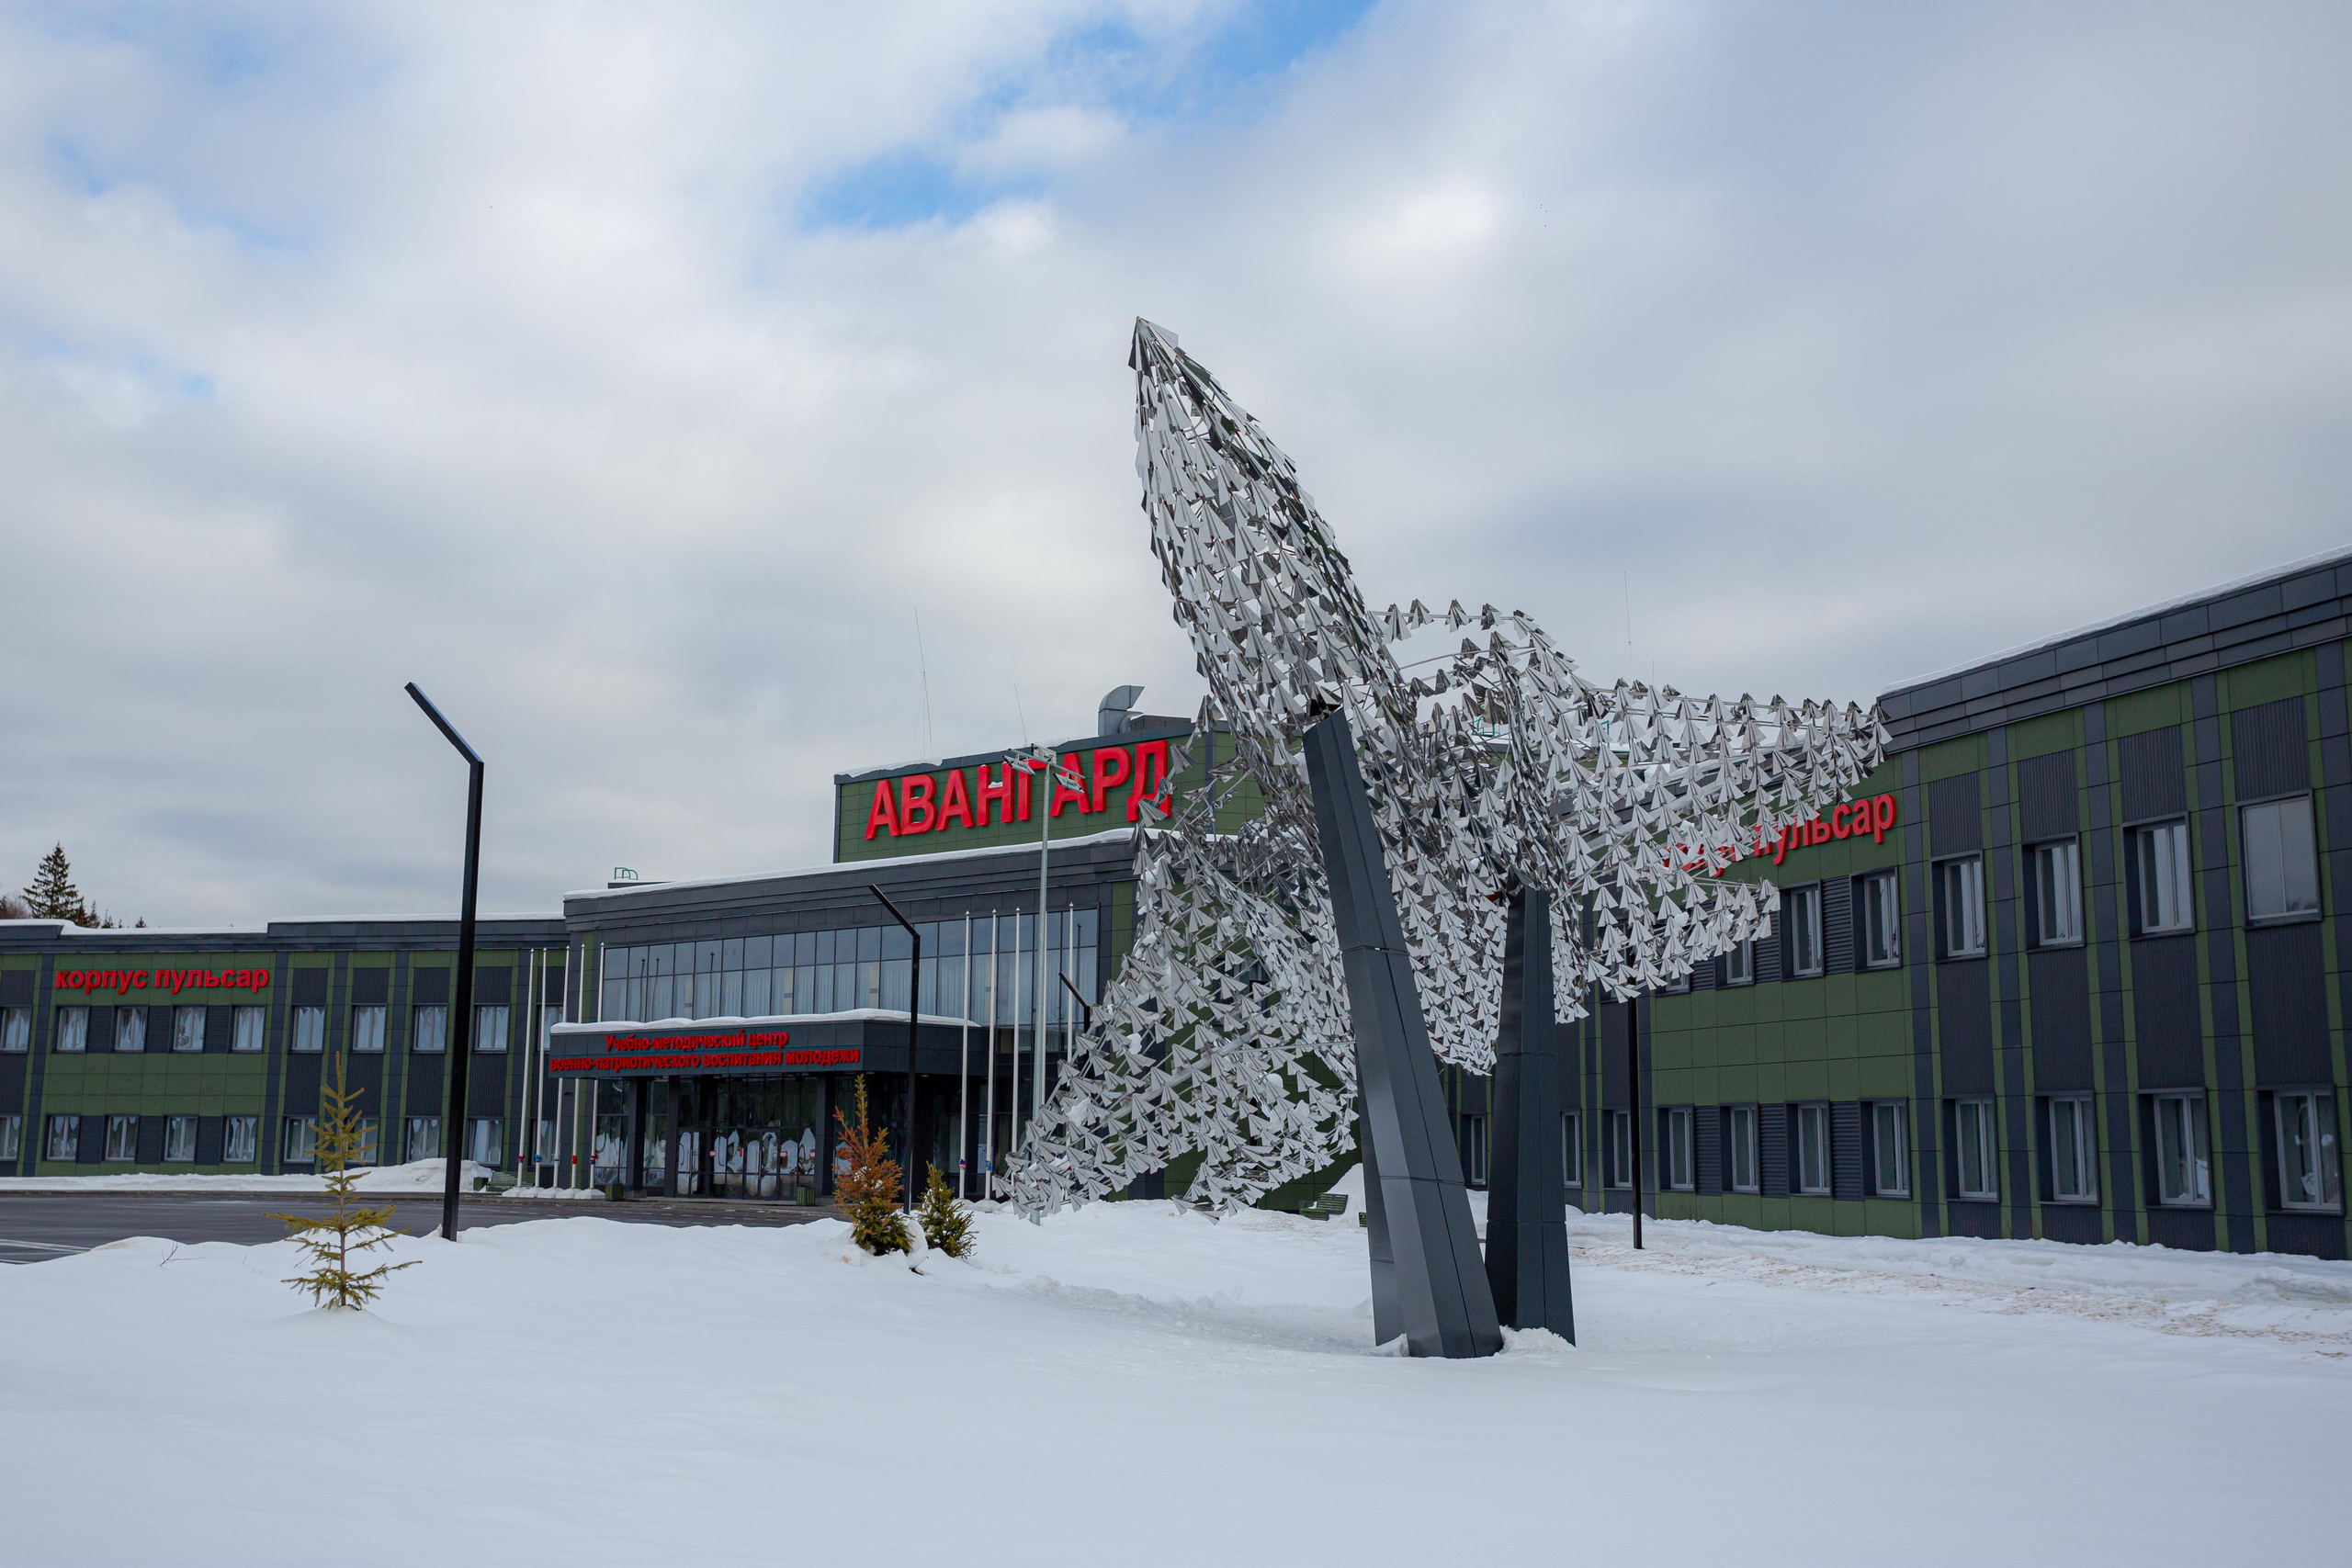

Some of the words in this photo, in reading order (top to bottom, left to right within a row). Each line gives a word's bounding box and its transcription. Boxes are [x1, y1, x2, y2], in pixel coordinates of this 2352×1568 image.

[864, 739, 1172, 840] АВАНГАРД
[55, 970, 148, 995] корпус
[154, 969, 269, 994] пульсар
[605, 1030, 746, 1053] Учебно-методический
[747, 1032, 789, 1049] центр
[549, 1055, 700, 1073] военно-патриотического
[702, 1051, 782, 1067] воспитания
[785, 1048, 861, 1066] молодежи
